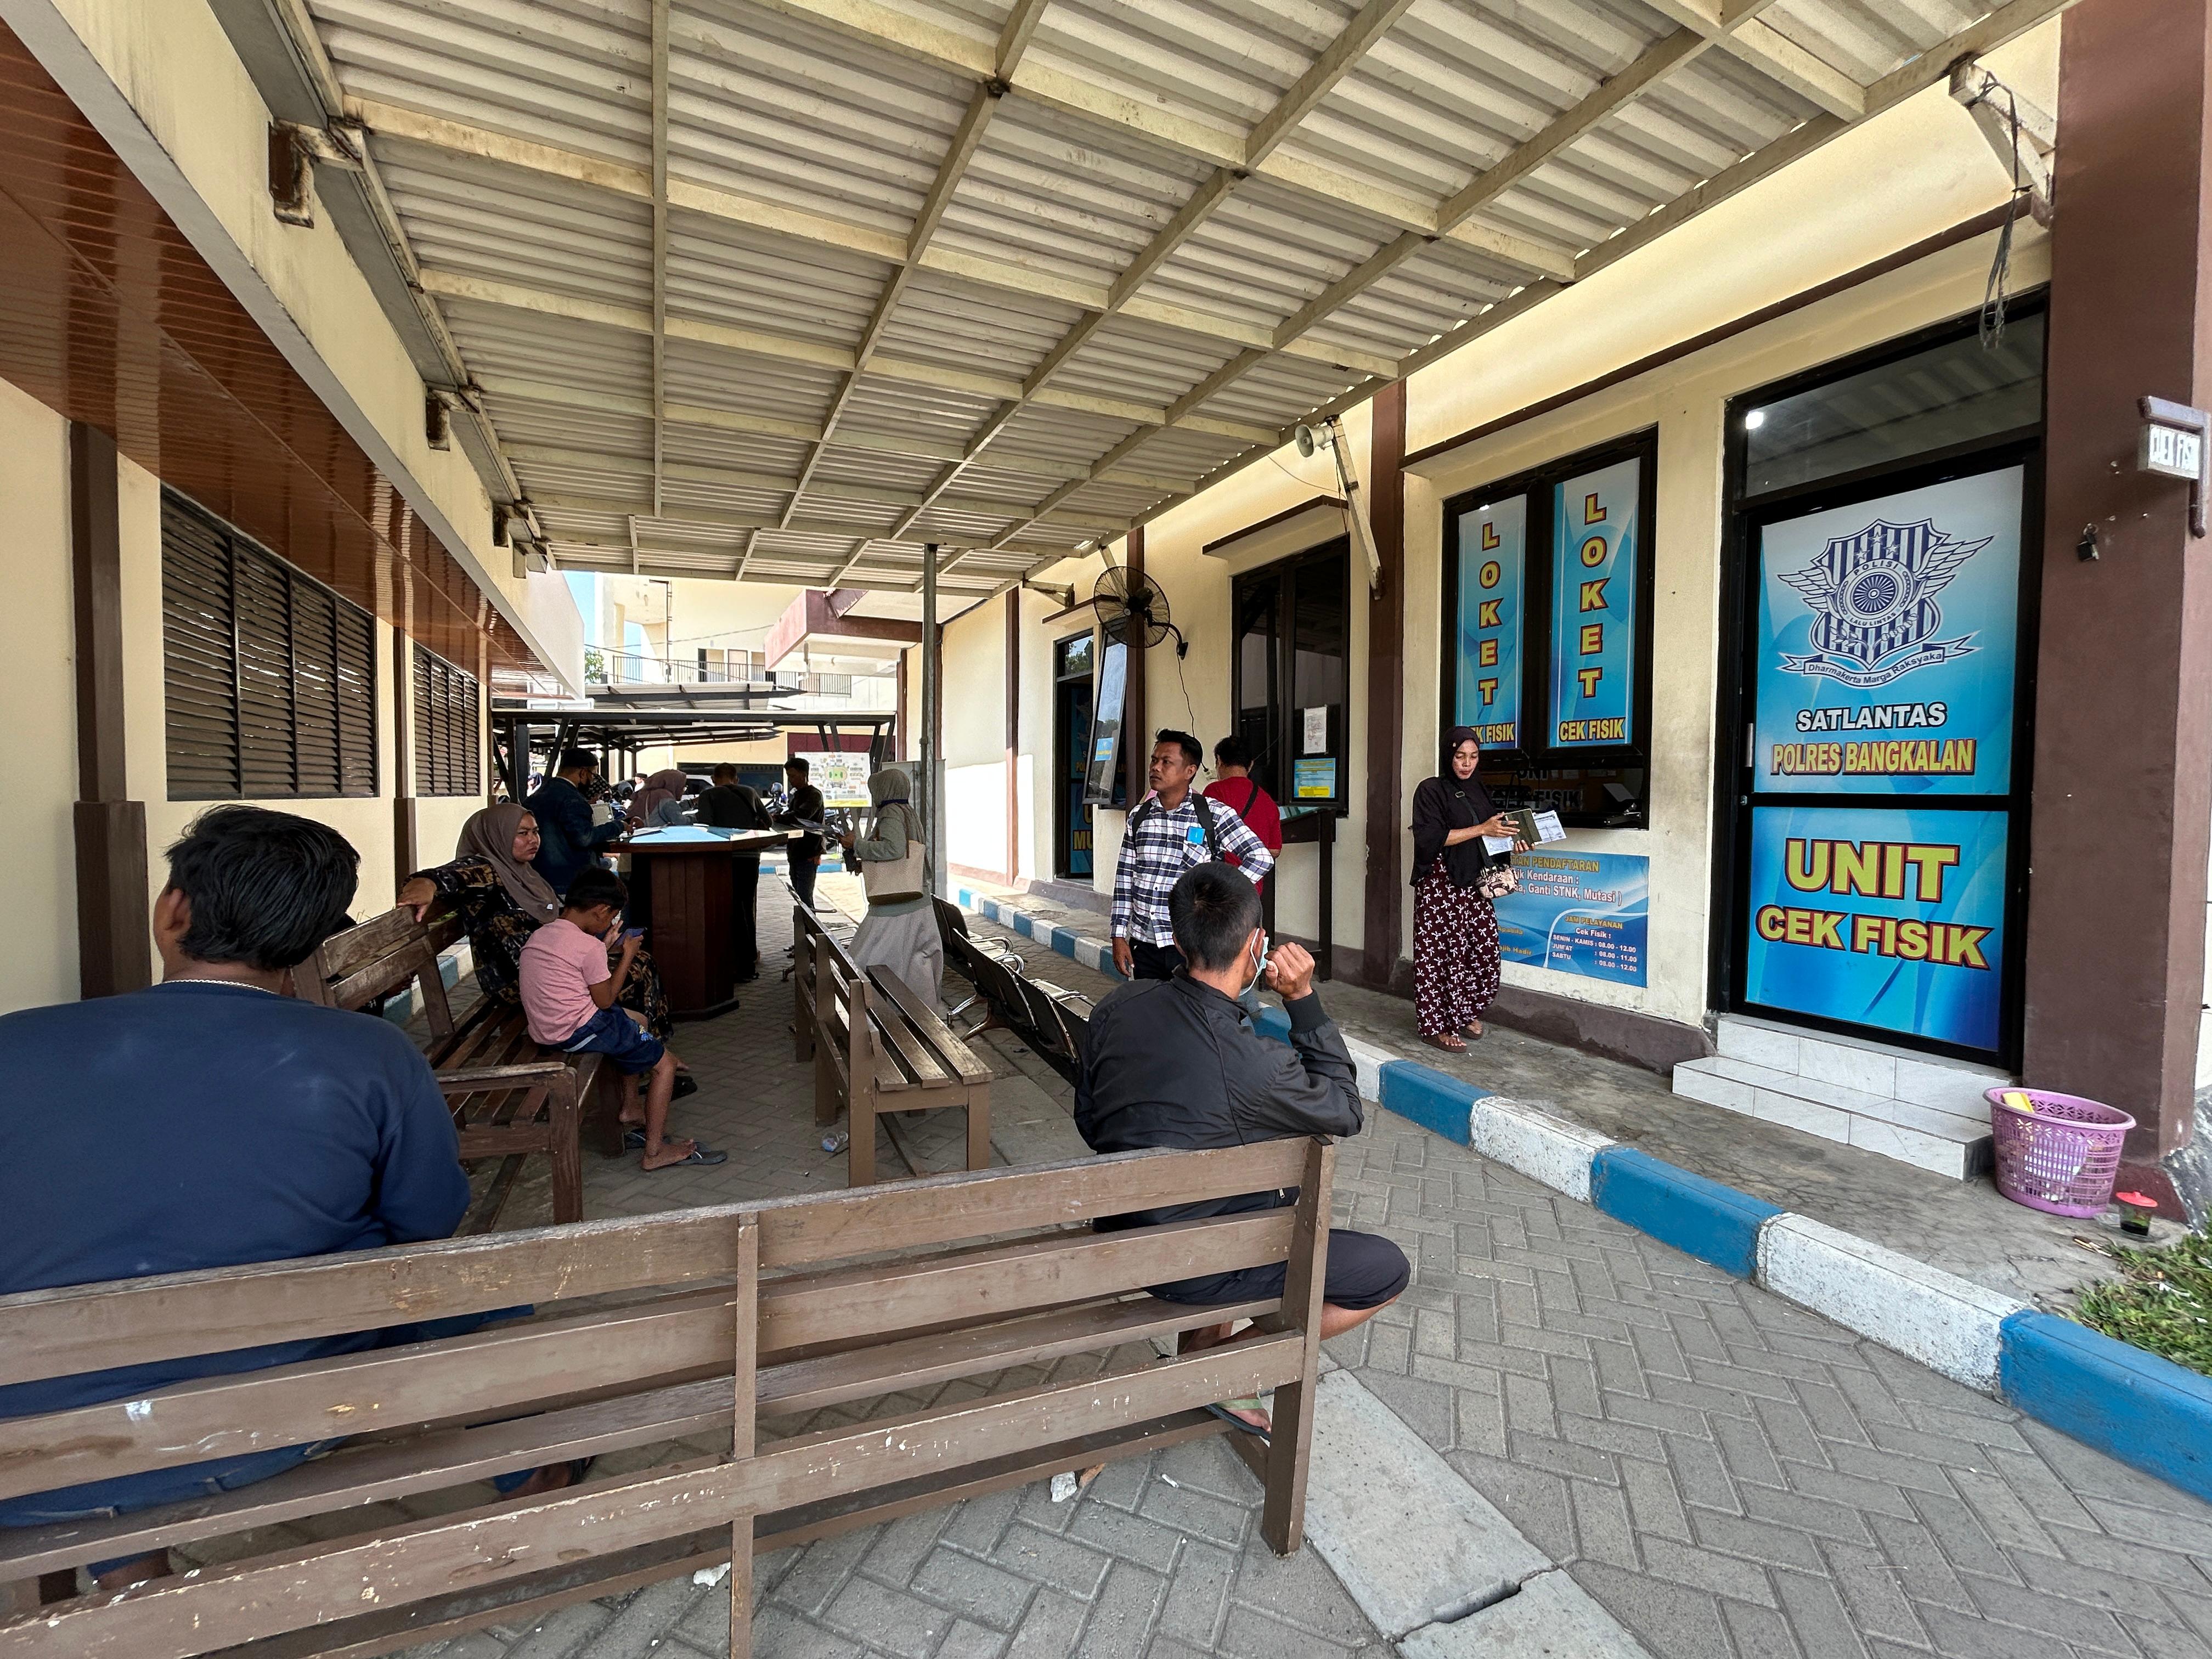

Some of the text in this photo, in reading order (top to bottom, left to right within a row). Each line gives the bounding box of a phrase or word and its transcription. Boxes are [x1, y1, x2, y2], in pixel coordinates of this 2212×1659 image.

[1854, 560, 1898, 575] POLISI
[1578, 492, 1611, 698] LOKET
[1479, 522, 1504, 707] LOKET
[1849, 612, 1896, 626] LALU LINTAS
[1808, 652, 1942, 684] Dharmakerta Marga Raksyaka
[1796, 701, 1948, 733] SATLANTAS
[1485, 723, 1515, 743] FISIK
[1559, 717, 1626, 742] CEK FISIK
[1770, 738, 1977, 775] POLRES BANGKALAN
[1532, 856, 1600, 873] PENDAFTARAN
[1784, 838, 1960, 904] UNIT
[1527, 869, 1573, 884] Kendaraan
[1528, 883, 1550, 896] Ganti
[1553, 885, 1581, 901] STNK,
[1584, 888, 1616, 903] Mutasi
[1565, 915, 1623, 930] JAM PELAYANAN
[1576, 927, 1589, 936] Cek
[1590, 929, 1607, 939] Fisik
[1756, 904, 1995, 970] CEK FISIK
[1553, 934, 1570, 943] SENIN
[1575, 938, 1594, 946] KAMIS
[1620, 945, 1636, 953] 12.00
[1552, 951, 1571, 960] SABTU
[1620, 964, 1637, 972] 12.00
[1620, 955, 1637, 963] 11.00
